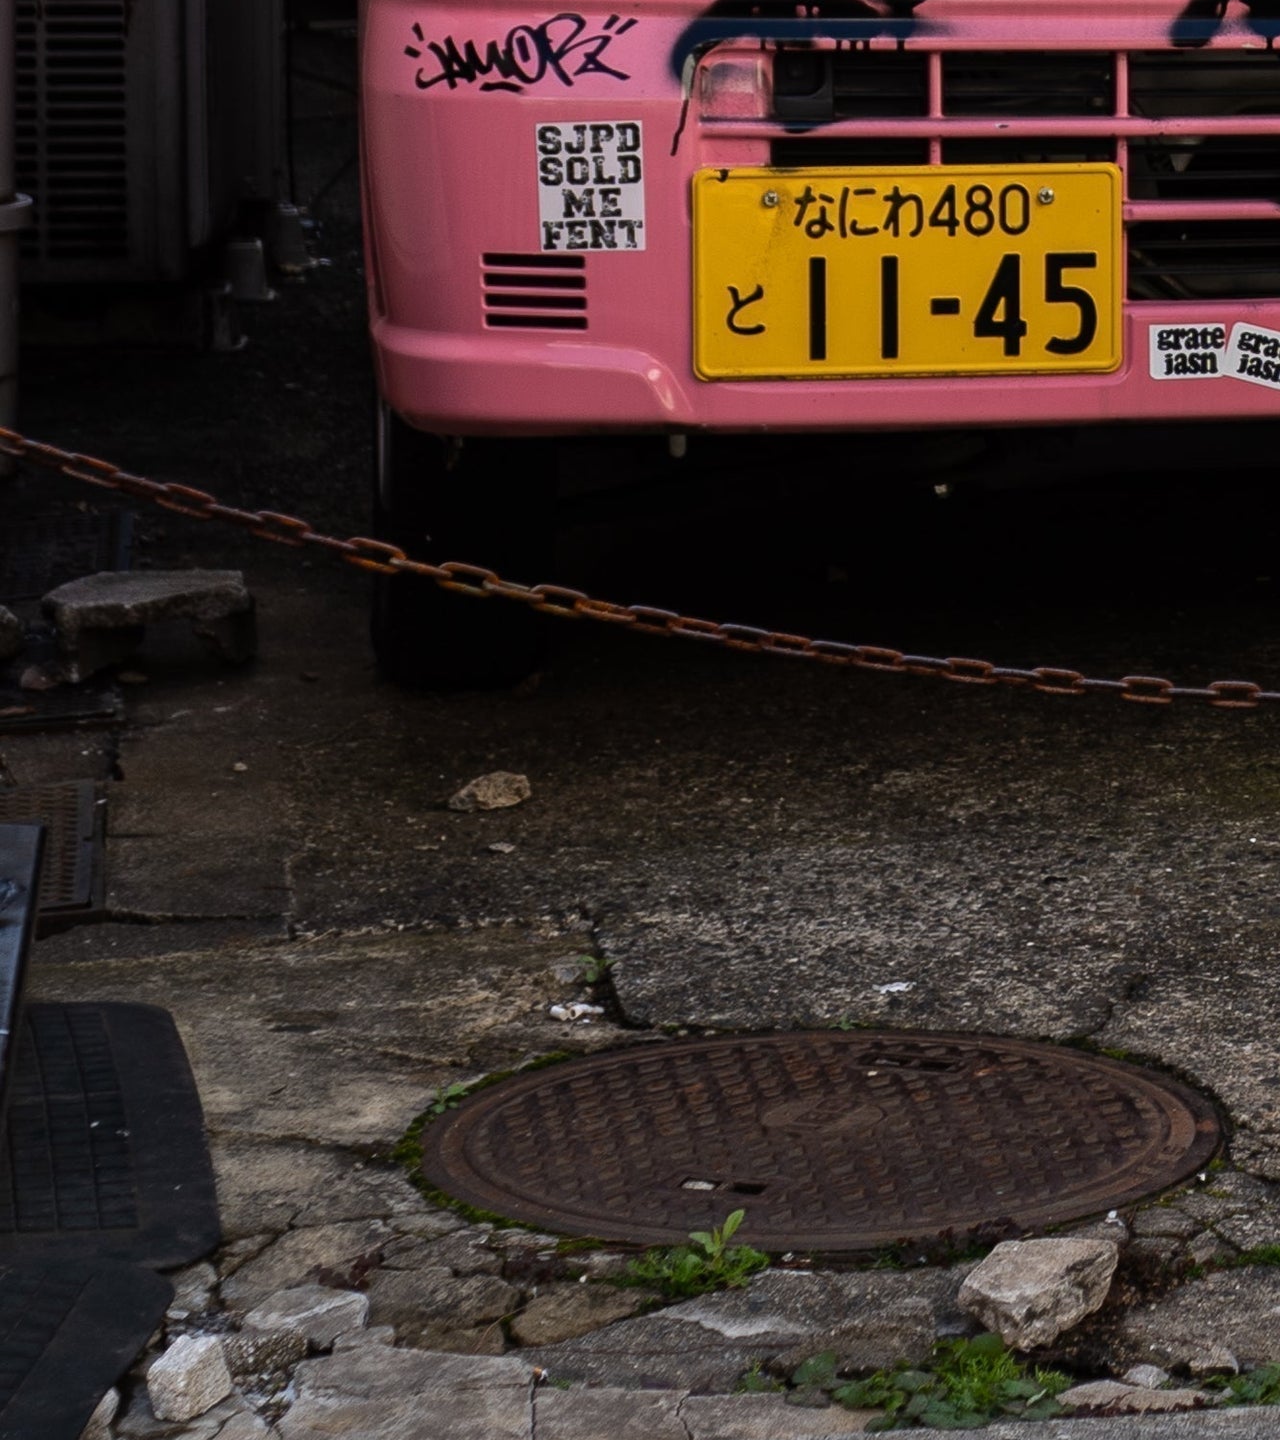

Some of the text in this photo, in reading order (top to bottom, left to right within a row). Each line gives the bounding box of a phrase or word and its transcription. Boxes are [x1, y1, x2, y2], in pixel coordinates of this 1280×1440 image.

[537, 122, 641, 155] SJPD
[539, 154, 642, 186] SOLD
[561, 187, 622, 218] ME
[542, 219, 643, 250] FENT
[725, 284, 766, 336] と
[808, 250, 1099, 361] 11-45
[1157, 326, 1226, 351] grate
[1164, 351, 1219, 376] jasn
